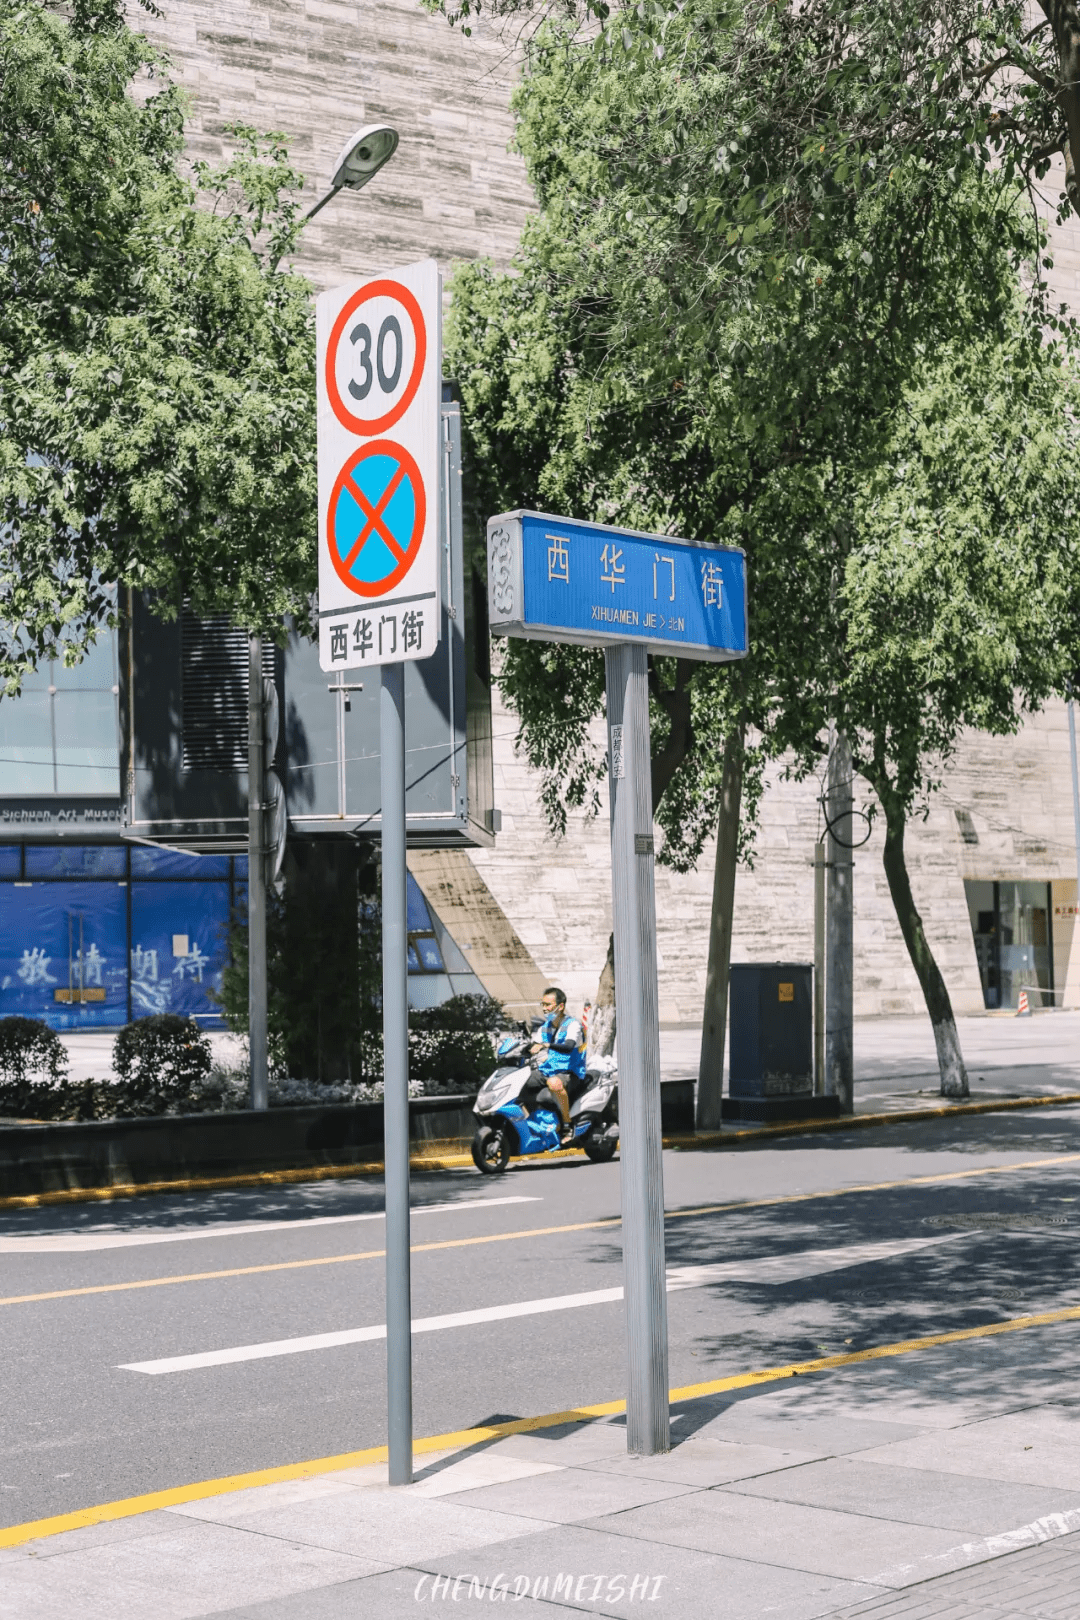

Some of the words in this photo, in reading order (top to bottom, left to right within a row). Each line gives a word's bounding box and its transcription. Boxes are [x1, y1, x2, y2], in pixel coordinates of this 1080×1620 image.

[348, 315, 403, 401] 30
[545, 533, 724, 610] 西华门街
[329, 610, 425, 663] 西华门街
[591, 605, 639, 626] XIHUAMEN
[643, 612, 657, 629] JIE
[612, 727, 624, 777] 成都公安
[2, 808, 51, 818] Sichuan
[56, 808, 77, 818] Art
[83, 808, 121, 818] Museu
